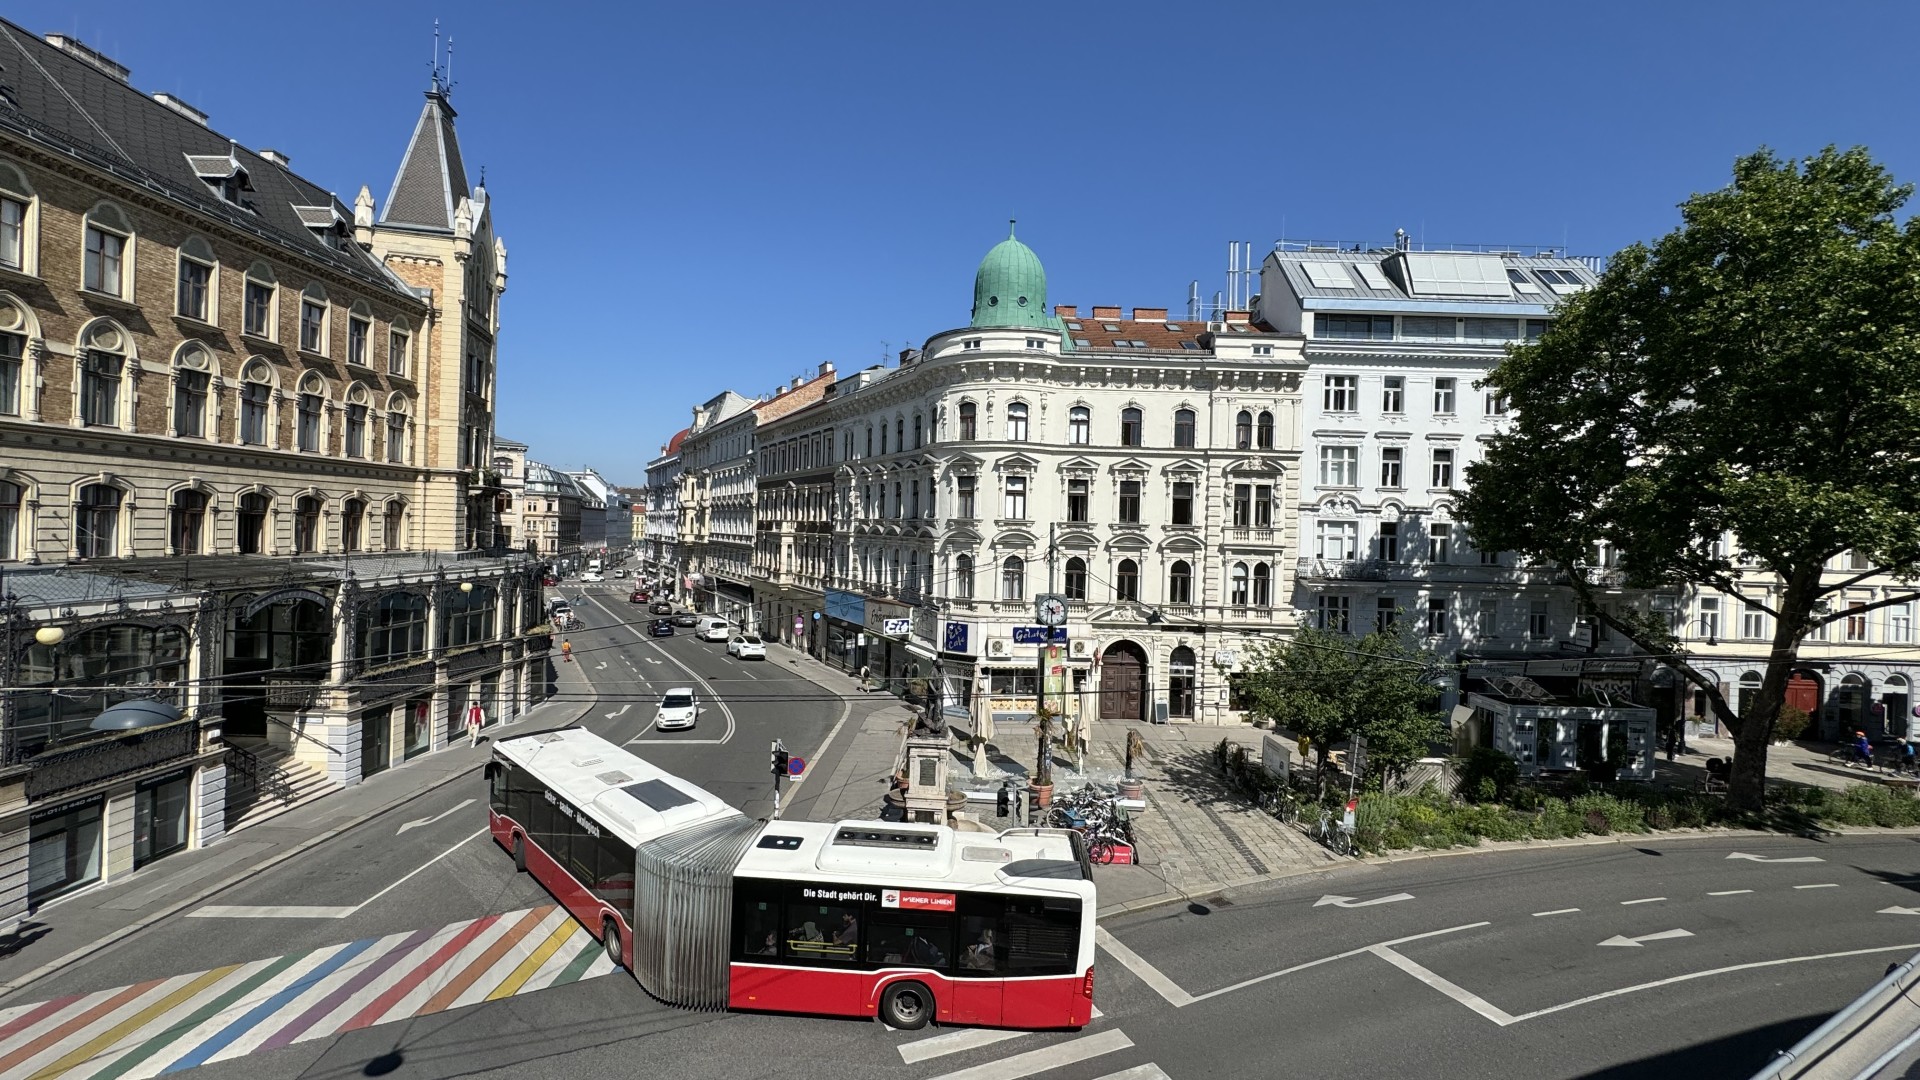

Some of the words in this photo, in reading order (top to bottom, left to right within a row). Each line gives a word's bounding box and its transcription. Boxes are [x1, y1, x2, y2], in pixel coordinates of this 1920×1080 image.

[885, 620, 909, 634] Eis
[948, 623, 963, 640] Eis
[803, 888, 816, 898] Die
[817, 889, 837, 899] Stadt
[838, 891, 863, 902] gehört
[864, 892, 878, 902] Dir.
[902, 896, 929, 905] WIENER
[930, 897, 953, 906] LINIEN
